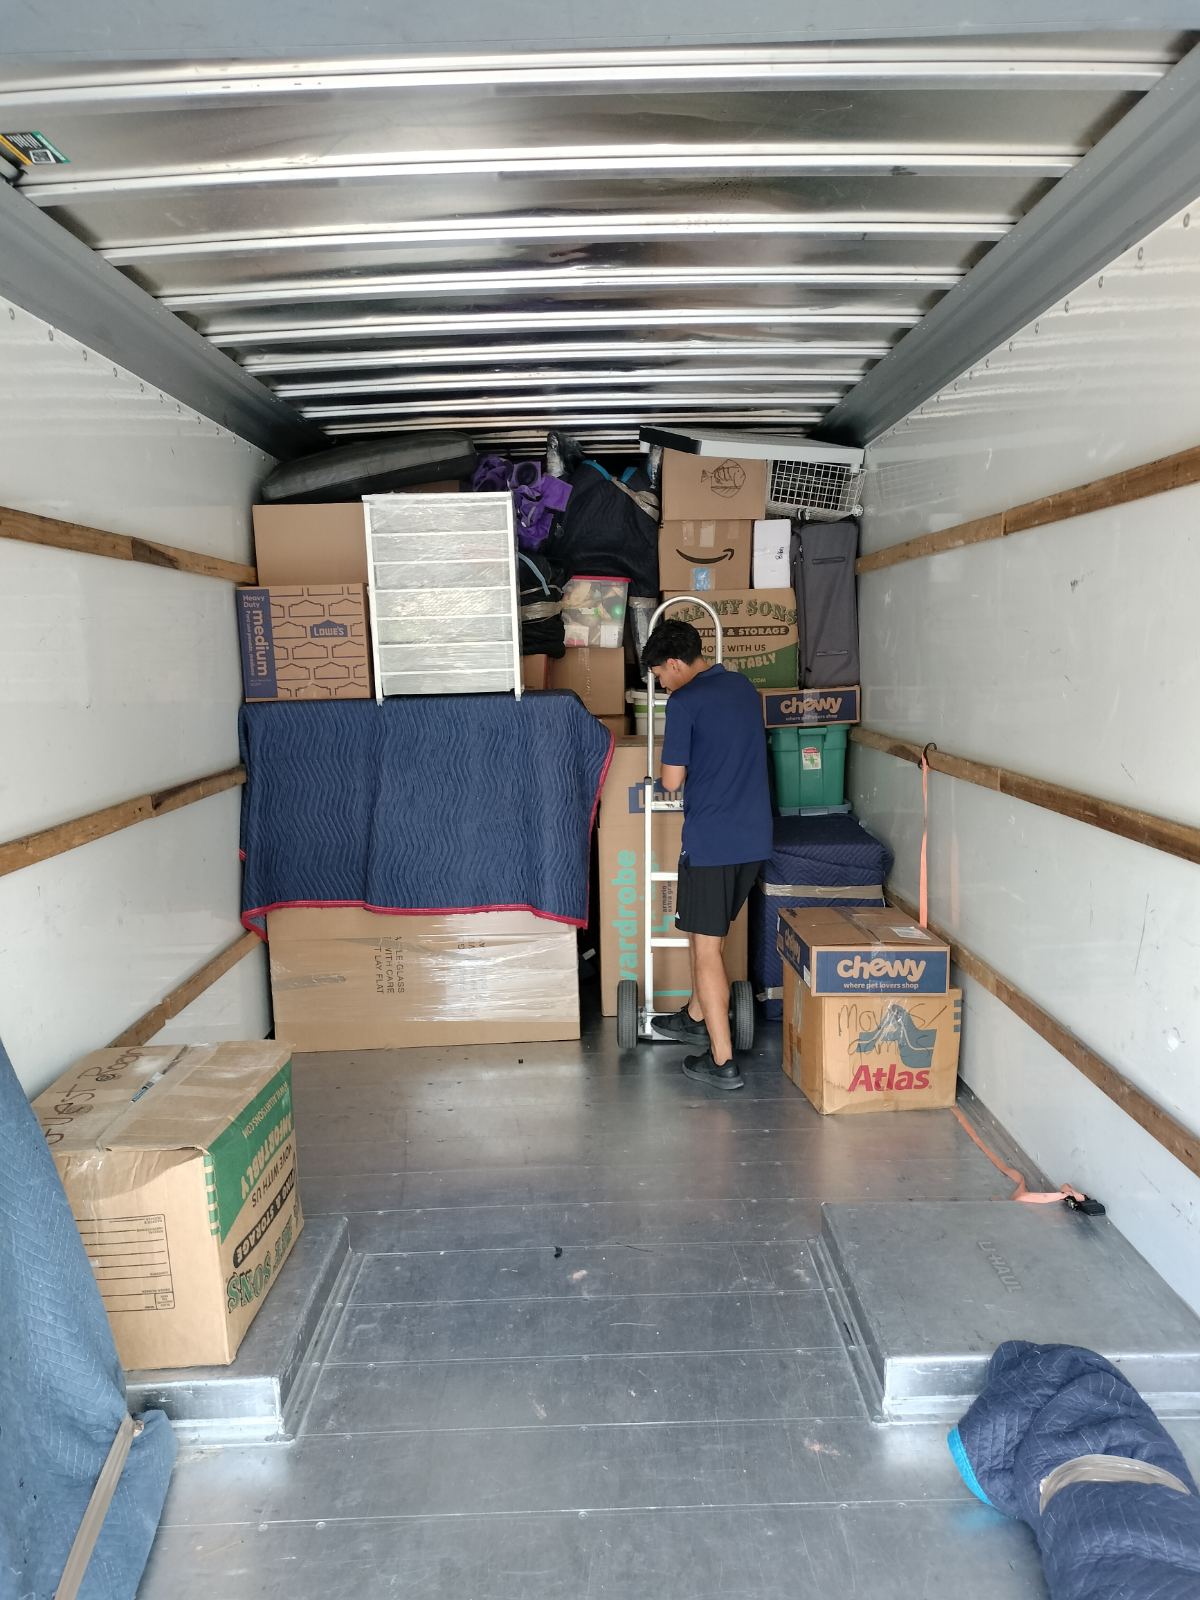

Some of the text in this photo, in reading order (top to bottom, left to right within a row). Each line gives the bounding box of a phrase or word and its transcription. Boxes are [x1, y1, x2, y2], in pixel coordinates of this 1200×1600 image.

[242, 594, 265, 602] Heavy
[747, 599, 797, 625] SONS
[252, 610, 270, 676] medium
[313, 625, 345, 637] LOWE'S
[726, 628, 736, 636] &
[738, 627, 786, 635] STORAGE
[754, 644, 766, 652] US
[780, 696, 843, 714] chewy
[374, 955, 382, 971] LAY
[836, 955, 927, 982] chewy
[375, 973, 384, 994] FLAT
[386, 969, 395, 994] CARE
[396, 963, 405, 994] GLASS
[866, 982, 878, 990] pet
[902, 982, 919, 990] shop
[847, 1064, 930, 1093] Atlas
[251, 1143, 292, 1208] OVE WITH US
[236, 1204, 275, 1263] STORAGE
[227, 1250, 272, 1314] SONS
